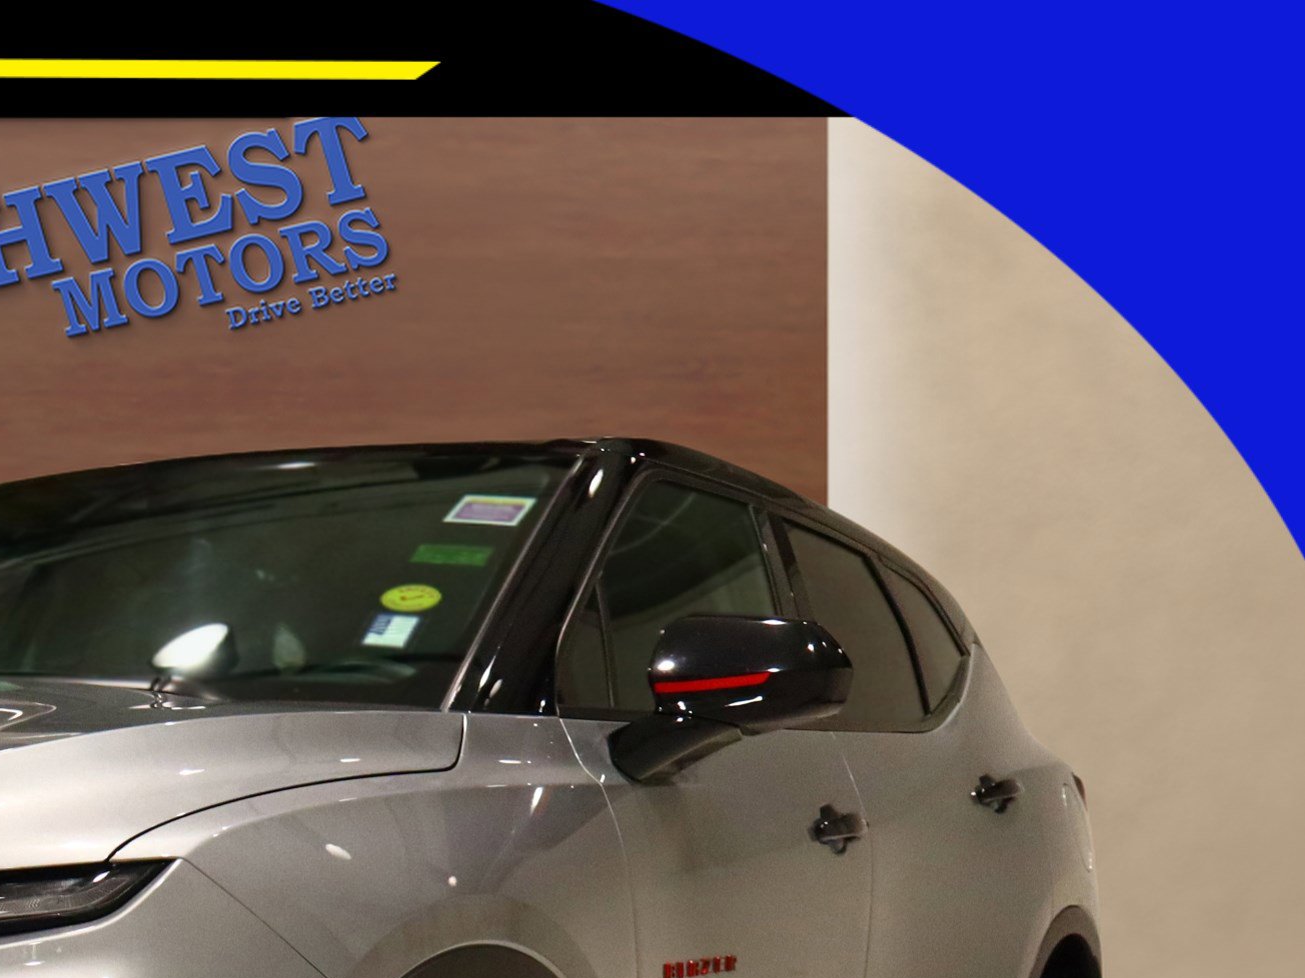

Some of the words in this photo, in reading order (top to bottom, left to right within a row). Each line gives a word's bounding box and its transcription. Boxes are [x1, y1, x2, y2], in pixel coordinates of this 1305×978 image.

[51, 207, 390, 338] MOTORS
[225, 296, 302, 331] Drive
[308, 273, 398, 310] Better
